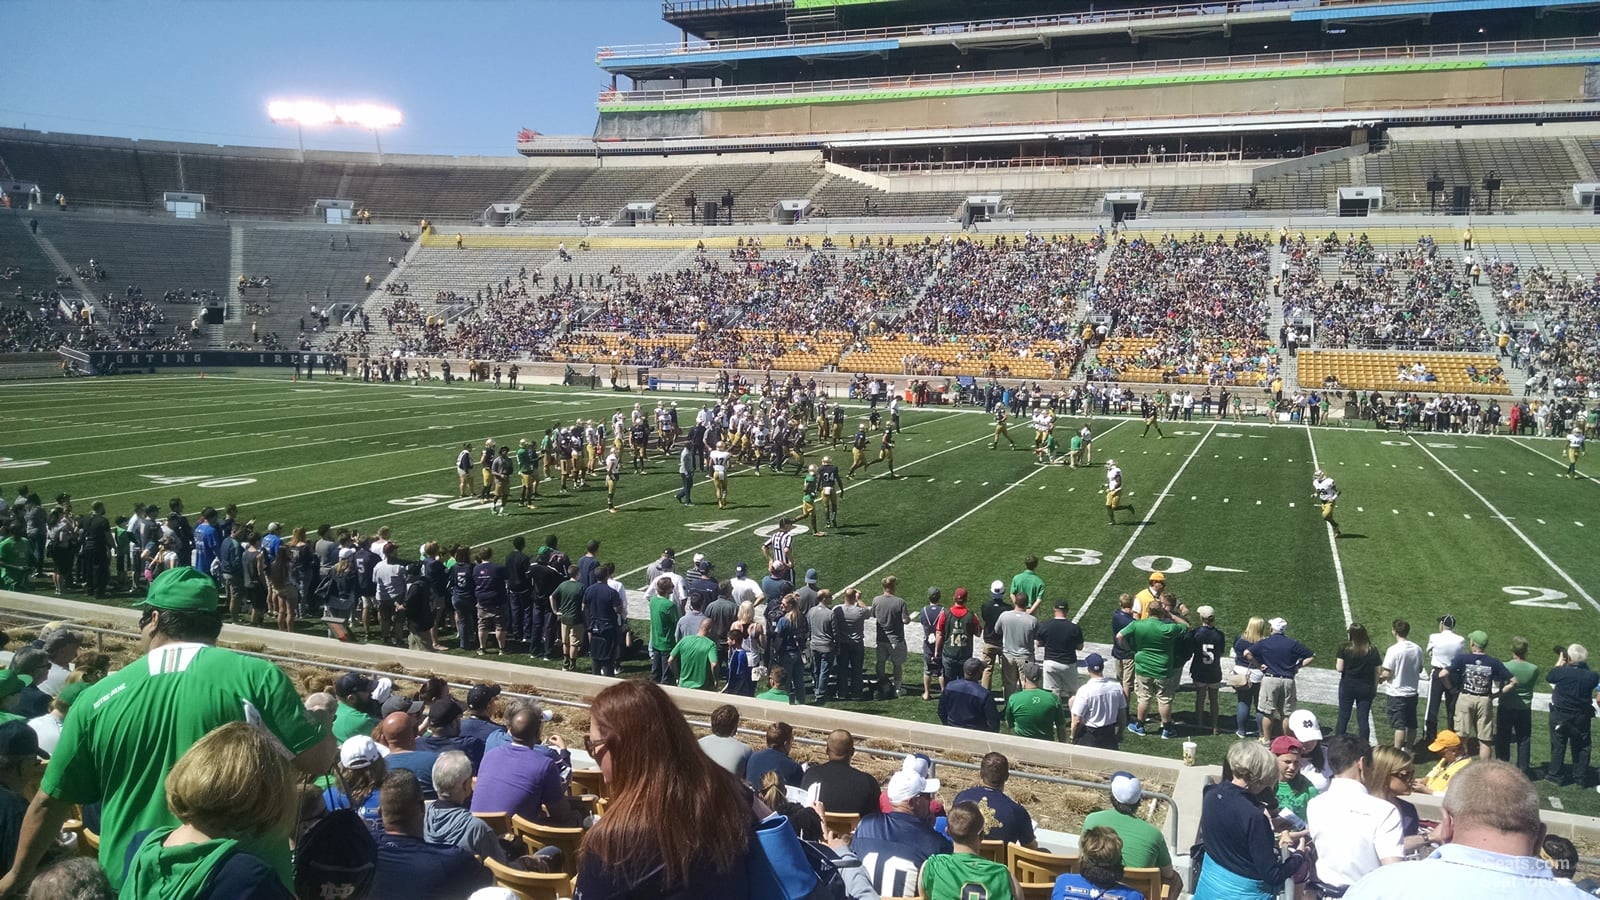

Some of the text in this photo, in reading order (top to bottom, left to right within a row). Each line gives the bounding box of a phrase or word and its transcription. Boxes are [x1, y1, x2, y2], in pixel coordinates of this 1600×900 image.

[823, 472, 836, 482] 34
[1202, 644, 1214, 665] 5
[862, 852, 918, 897] 10
